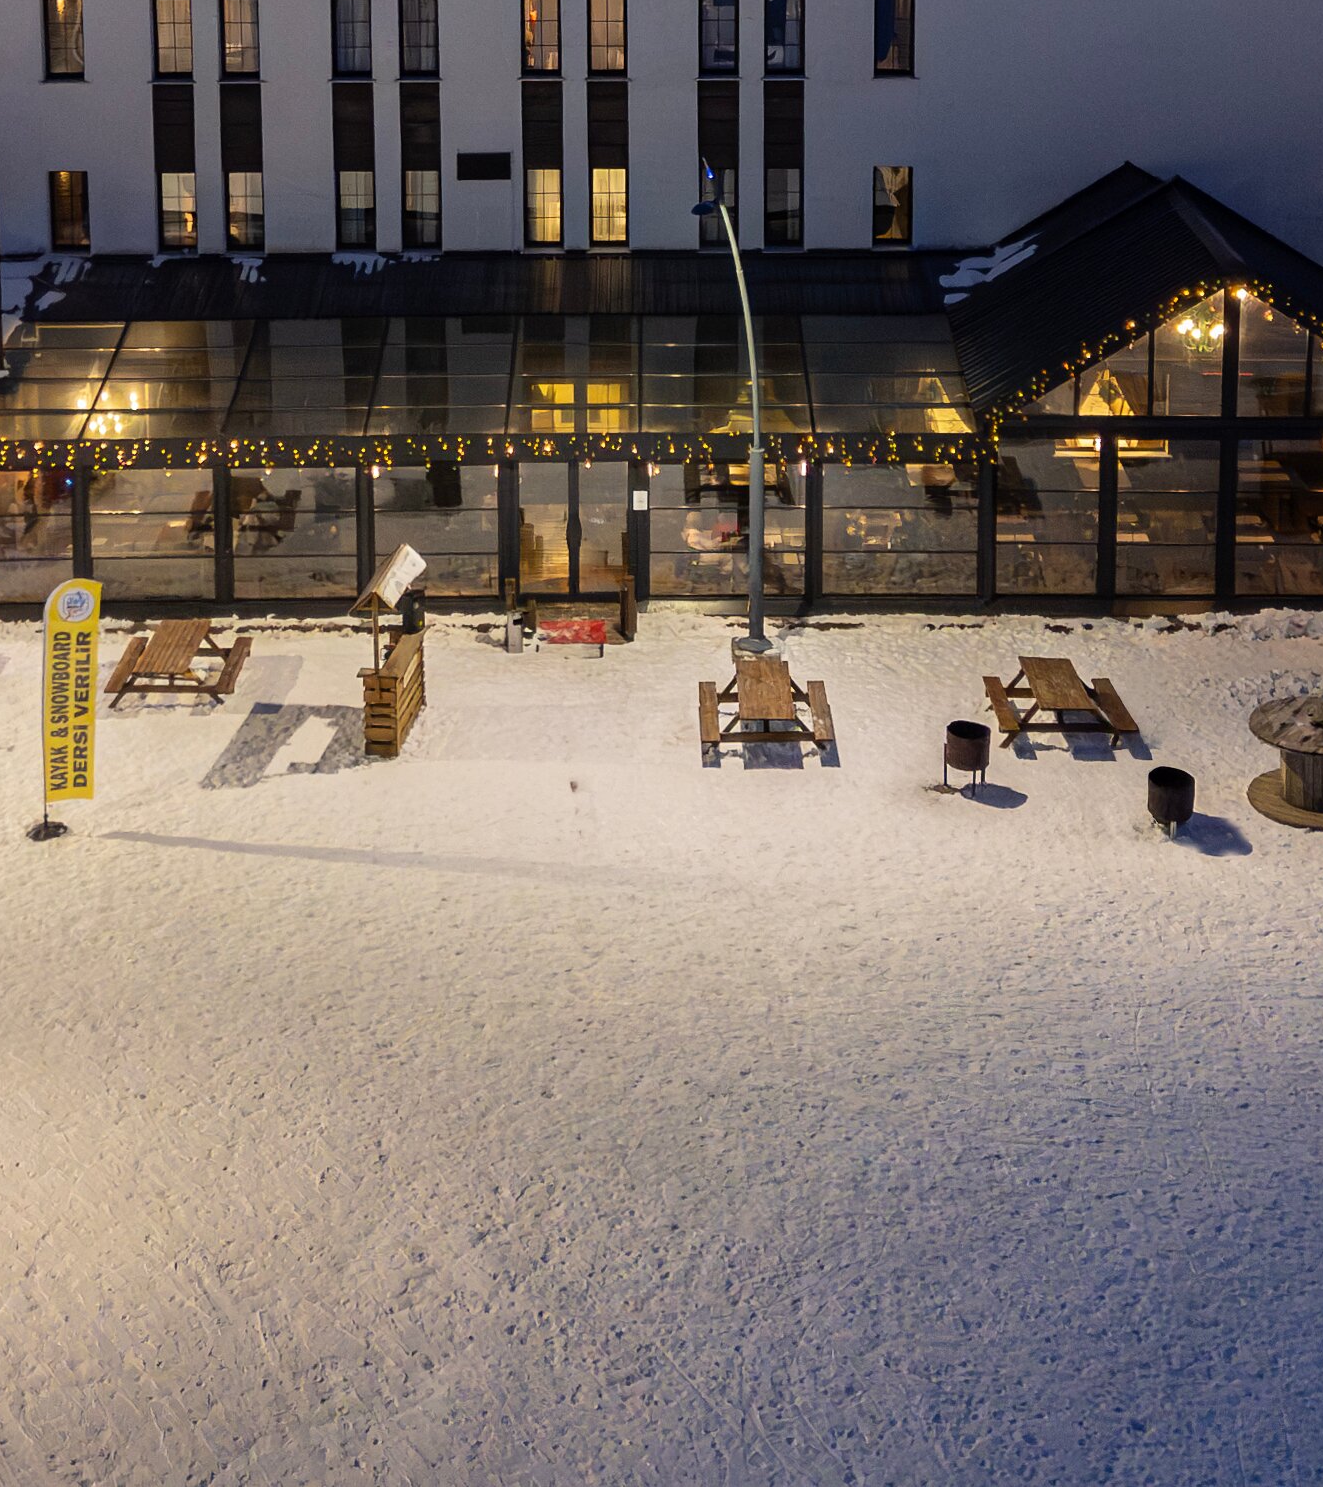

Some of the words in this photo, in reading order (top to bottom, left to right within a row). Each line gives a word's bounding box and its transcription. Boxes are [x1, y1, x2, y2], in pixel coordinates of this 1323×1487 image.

[51, 631, 71, 724] SNOWBOARD
[51, 726, 69, 739] &
[50, 745, 68, 791] KAYAK
